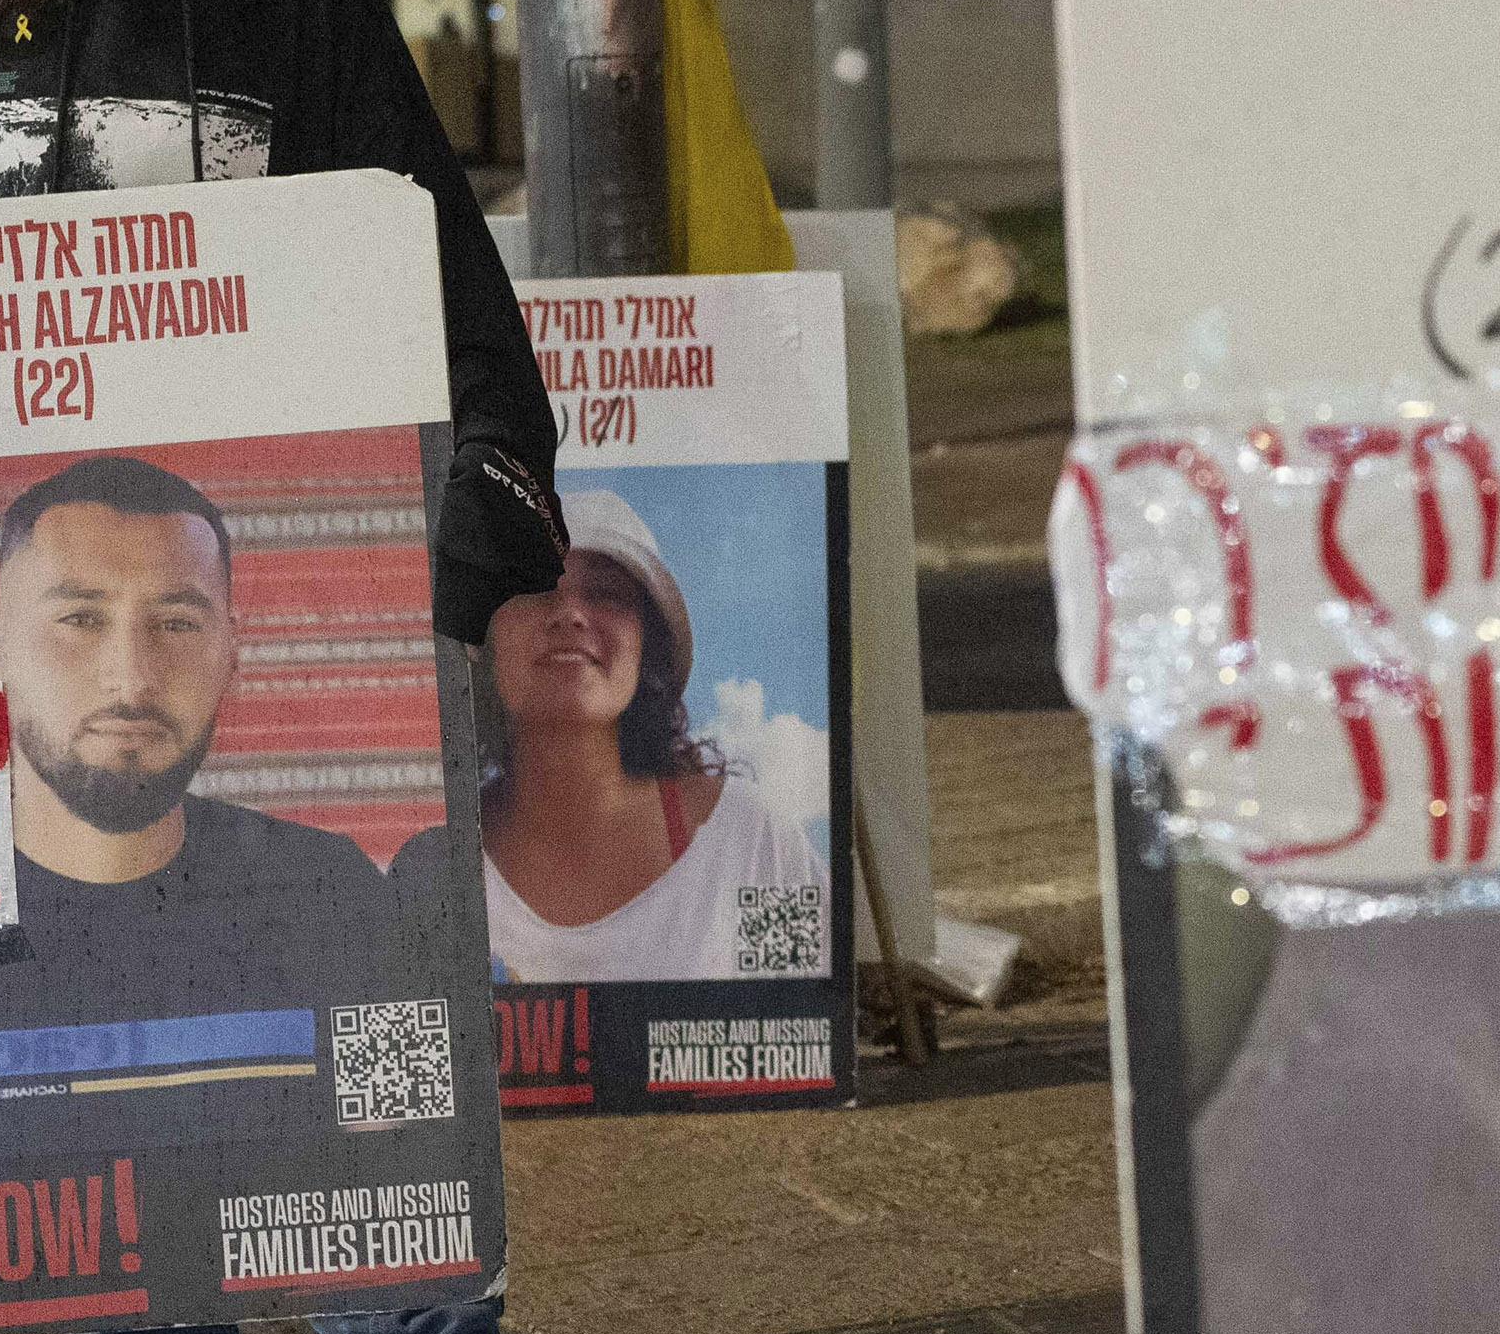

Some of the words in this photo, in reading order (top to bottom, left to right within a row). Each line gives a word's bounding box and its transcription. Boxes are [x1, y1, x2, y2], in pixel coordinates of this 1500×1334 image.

[92, 211, 198, 277] חמזה
[34, 275, 249, 351] ALZAYADNI
[614, 294, 698, 339] אמילי
[13, 352, 94, 426] (22)
[598, 343, 714, 392] DAMARI
[493, 988, 590, 1074] OW!
[649, 1020, 726, 1046] HOSTAGES
[728, 1019, 760, 1044] AND
[762, 1017, 832, 1043] MISSING
[650, 1045, 748, 1083] FAMILIES
[752, 1043, 832, 1081] FORUM
[219, 1191, 325, 1230] HOSTAGES
[331, 1187, 372, 1222] AND
[377, 1180, 471, 1218] MISSING
[222, 1224, 357, 1280] FAMILIES
[366, 1215, 475, 1270] FORUM
